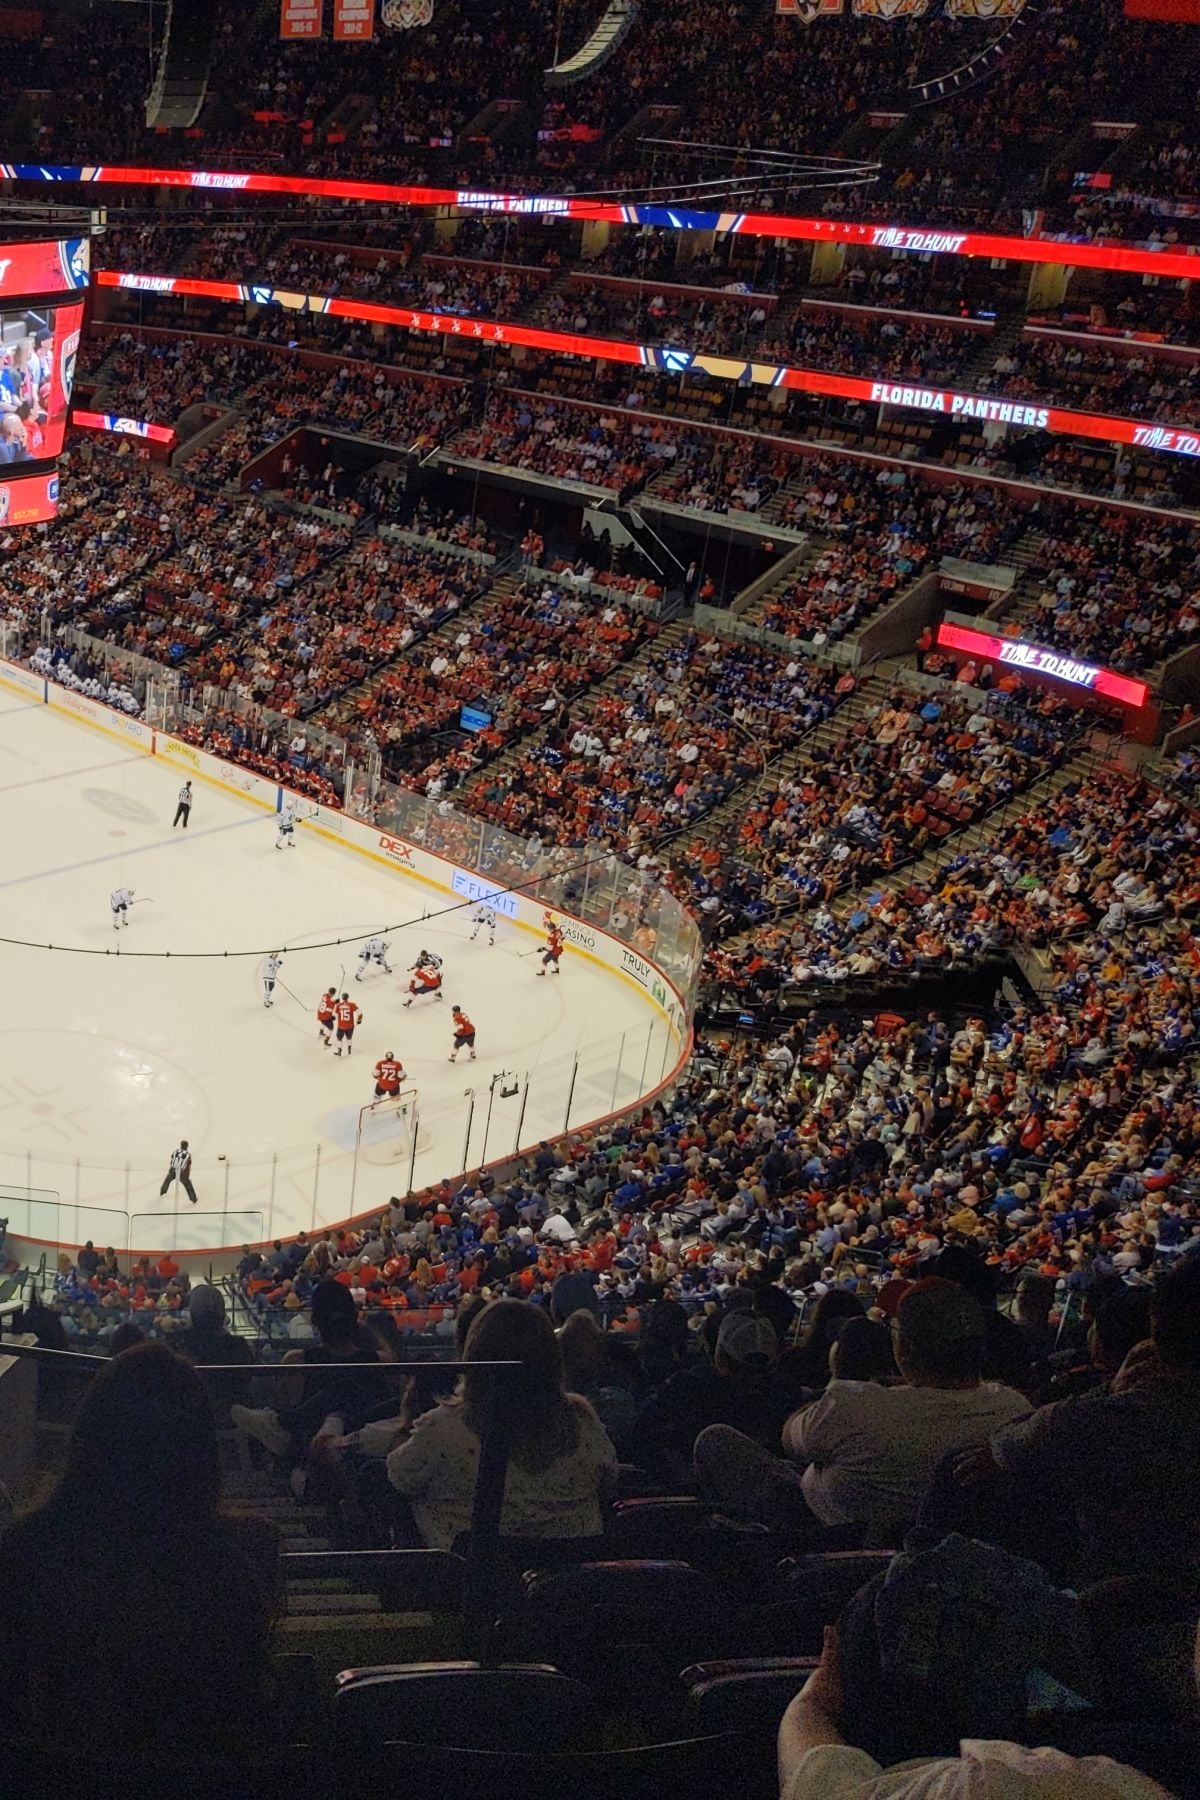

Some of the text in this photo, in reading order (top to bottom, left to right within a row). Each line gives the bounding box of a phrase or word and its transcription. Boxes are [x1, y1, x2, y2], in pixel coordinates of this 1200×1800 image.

[223, 175, 250, 188] HUNT
[457, 192, 570, 216] FLORIDA PANTHERS
[872, 228, 967, 252] TIME TO HUNT
[119, 274, 176, 290] TIME TO HUNT
[871, 383, 1049, 428] FLORIDA PANTHERS
[1132, 427, 1199, 453] TIME TO
[999, 643, 1098, 685] TIME TO HUNT
[379, 836, 414, 859] DEX
[385, 852, 416, 869] imaging
[469, 882, 517, 913] FLEXIT
[559, 924, 596, 948] CASINO
[622, 949, 651, 979] TRULY
[340, 1009, 351, 1021] 15
[381, 1068, 396, 1081] 72
